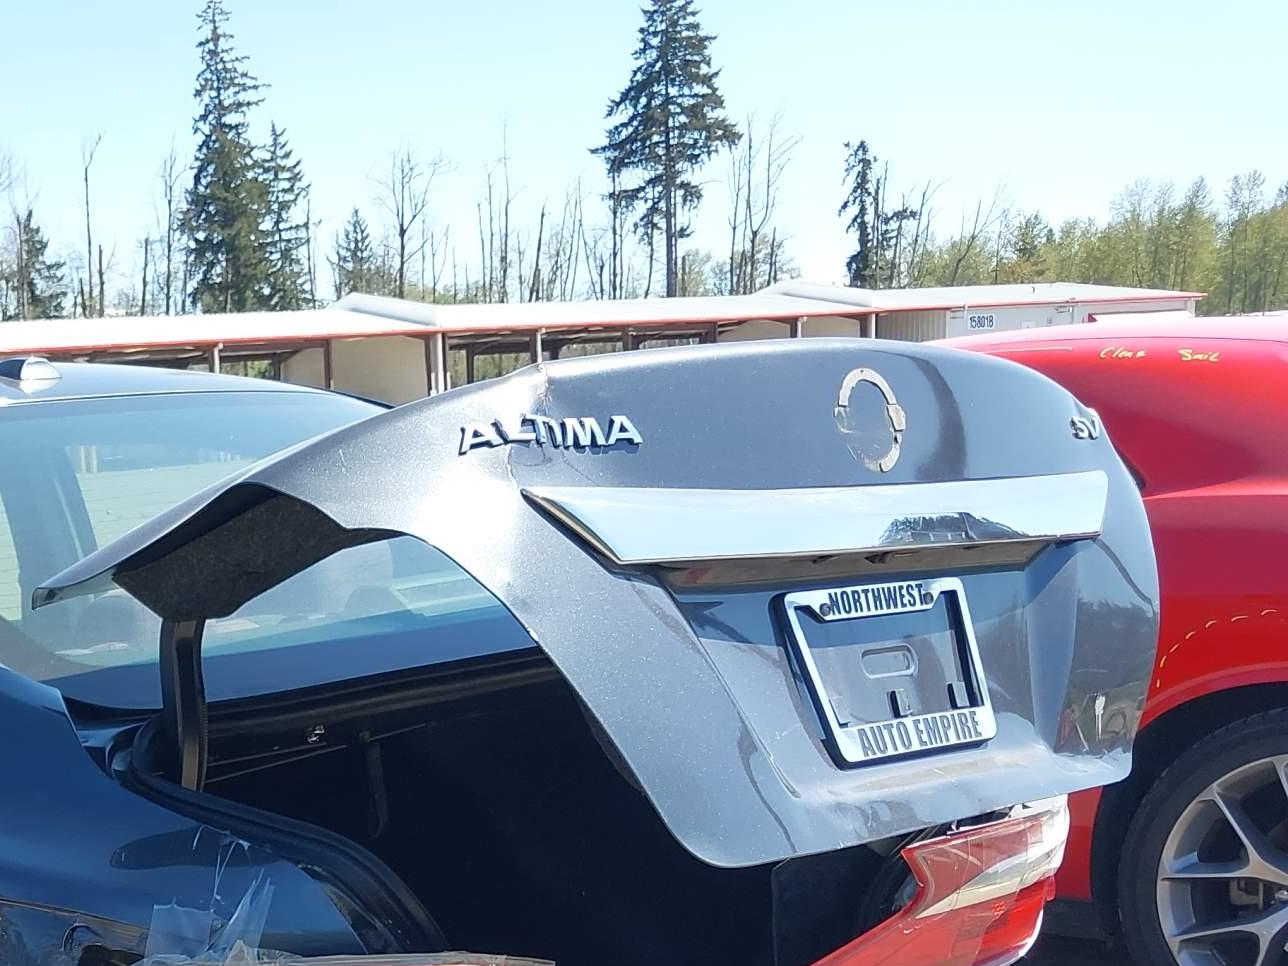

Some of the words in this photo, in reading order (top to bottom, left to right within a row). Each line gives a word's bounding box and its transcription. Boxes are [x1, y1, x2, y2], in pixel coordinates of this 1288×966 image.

[458, 414, 644, 456] ALTIMA
[827, 582, 925, 617] NORTHWEST
[856, 722, 913, 758] AUTO
[912, 710, 983, 749] EMPIRE
